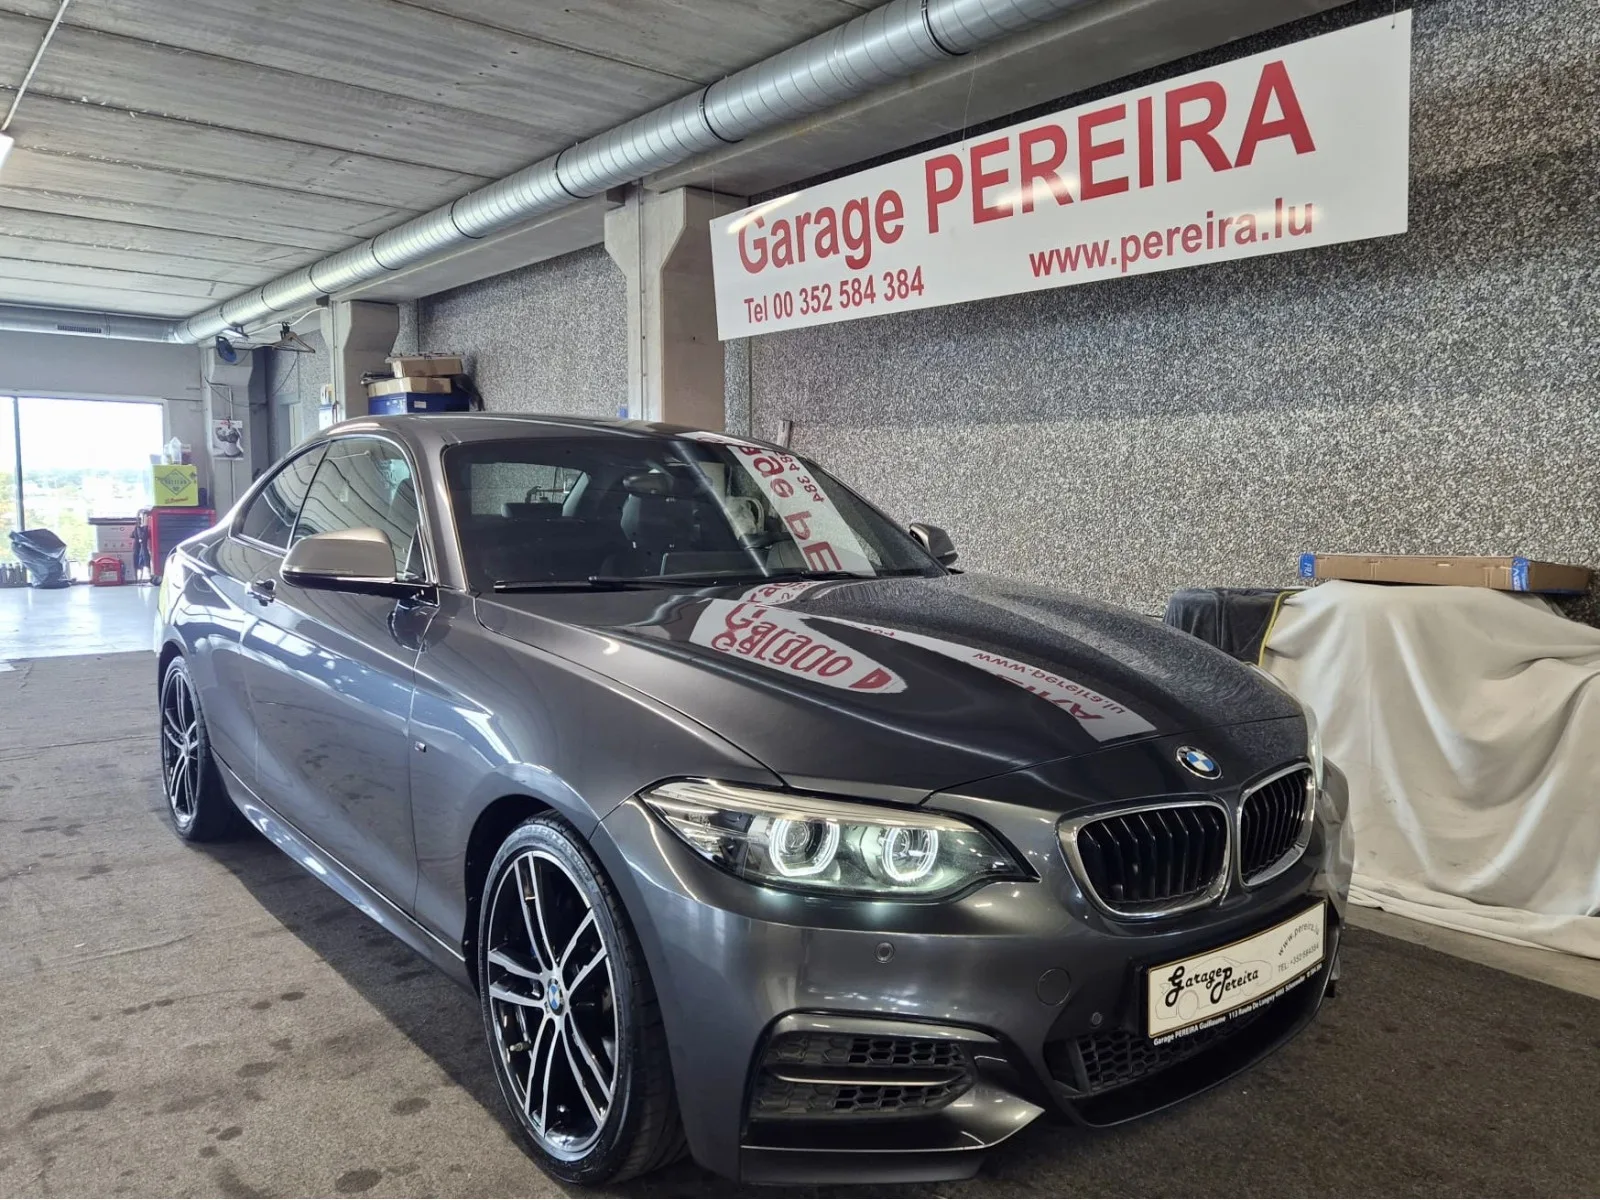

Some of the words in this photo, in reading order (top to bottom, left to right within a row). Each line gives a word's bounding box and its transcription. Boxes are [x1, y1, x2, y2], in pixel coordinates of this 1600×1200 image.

[738, 190, 904, 274] Garage
[924, 60, 1316, 234] PEREIRA
[1029, 198, 1313, 278] www.pereira.lu
[744, 295, 768, 324] Tel
[773, 290, 795, 321] 00
[799, 283, 834, 316] 352
[839, 274, 876, 310] 584
[883, 265, 925, 302] 384
[1165, 965, 1223, 1008] Garage
[1210, 966, 1259, 1004] Pereira
[1153, 1034, 1175, 1046] Garage
[1174, 1024, 1199, 1039] PEREIRA
